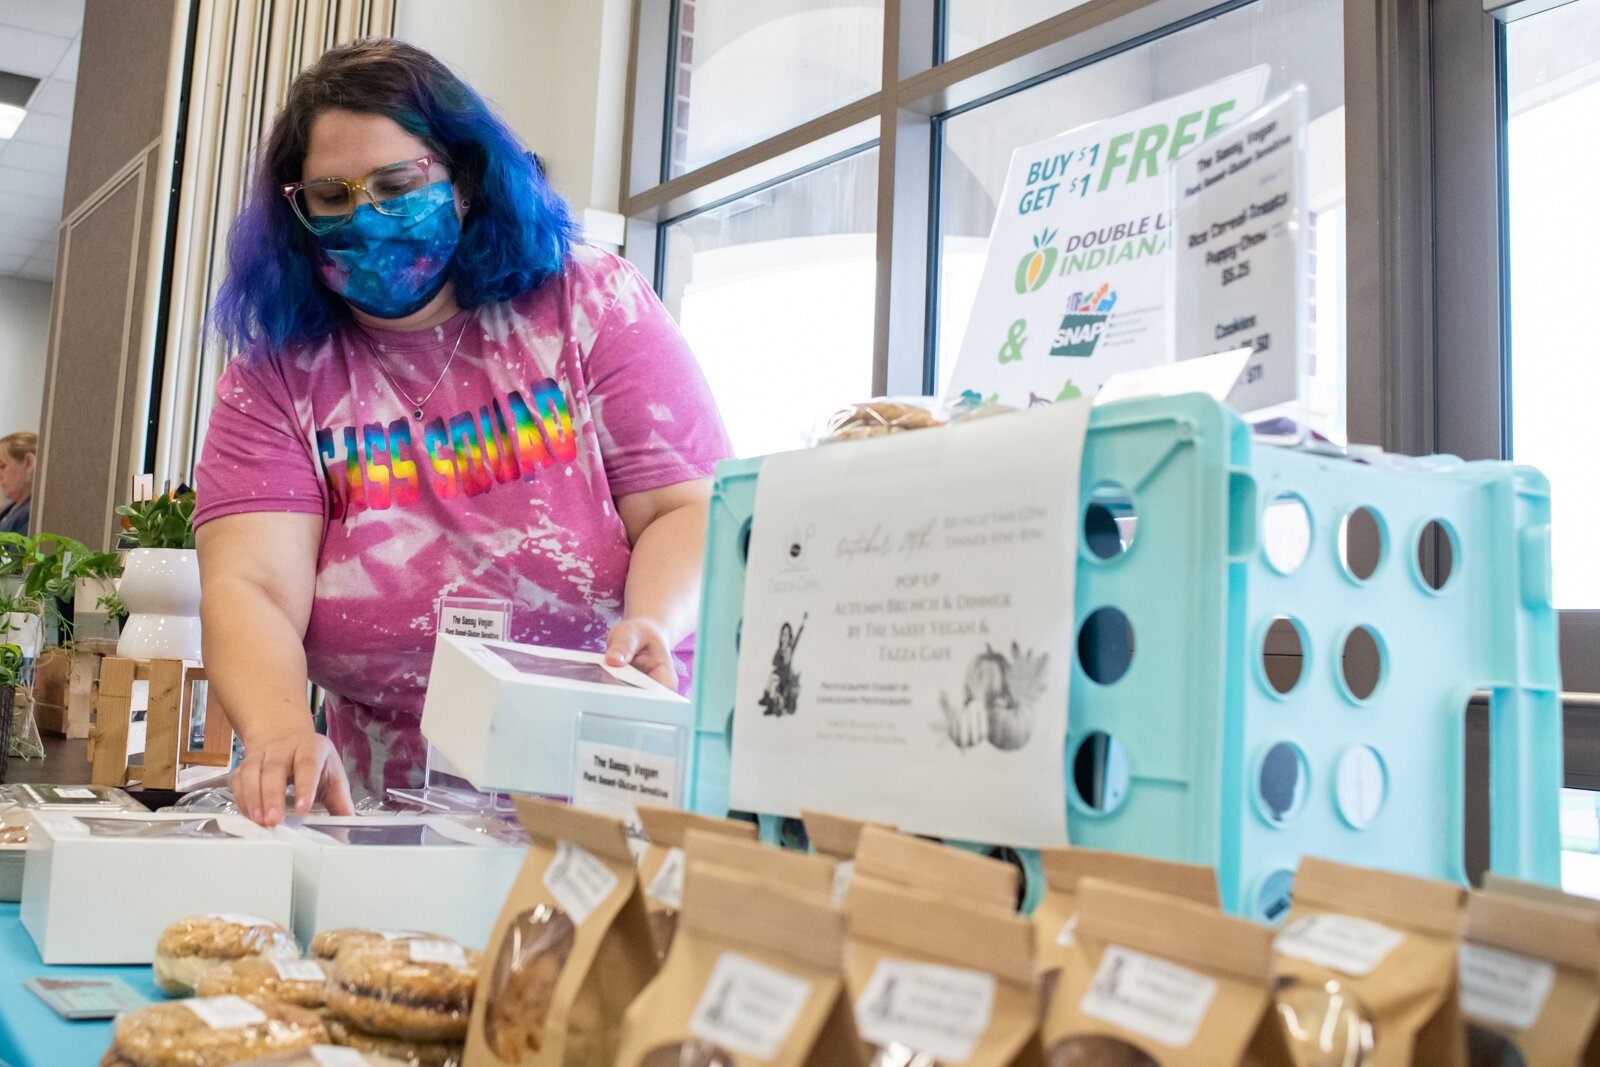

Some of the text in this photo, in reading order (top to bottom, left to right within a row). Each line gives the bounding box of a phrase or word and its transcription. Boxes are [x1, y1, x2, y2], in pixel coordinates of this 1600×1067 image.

[1026, 142, 1100, 185] BUY $1
[1097, 99, 1236, 192] FREE
[1018, 173, 1091, 215] GET $1
[1065, 217, 1150, 253] DOUBLE
[998, 318, 1028, 364] &
[1051, 322, 1105, 350] SNAP
[424, 378, 577, 498] SQUAD
[453, 615, 493, 629] The Sassy Vegan
[593, 754, 659, 781] The Sassy Vegan
